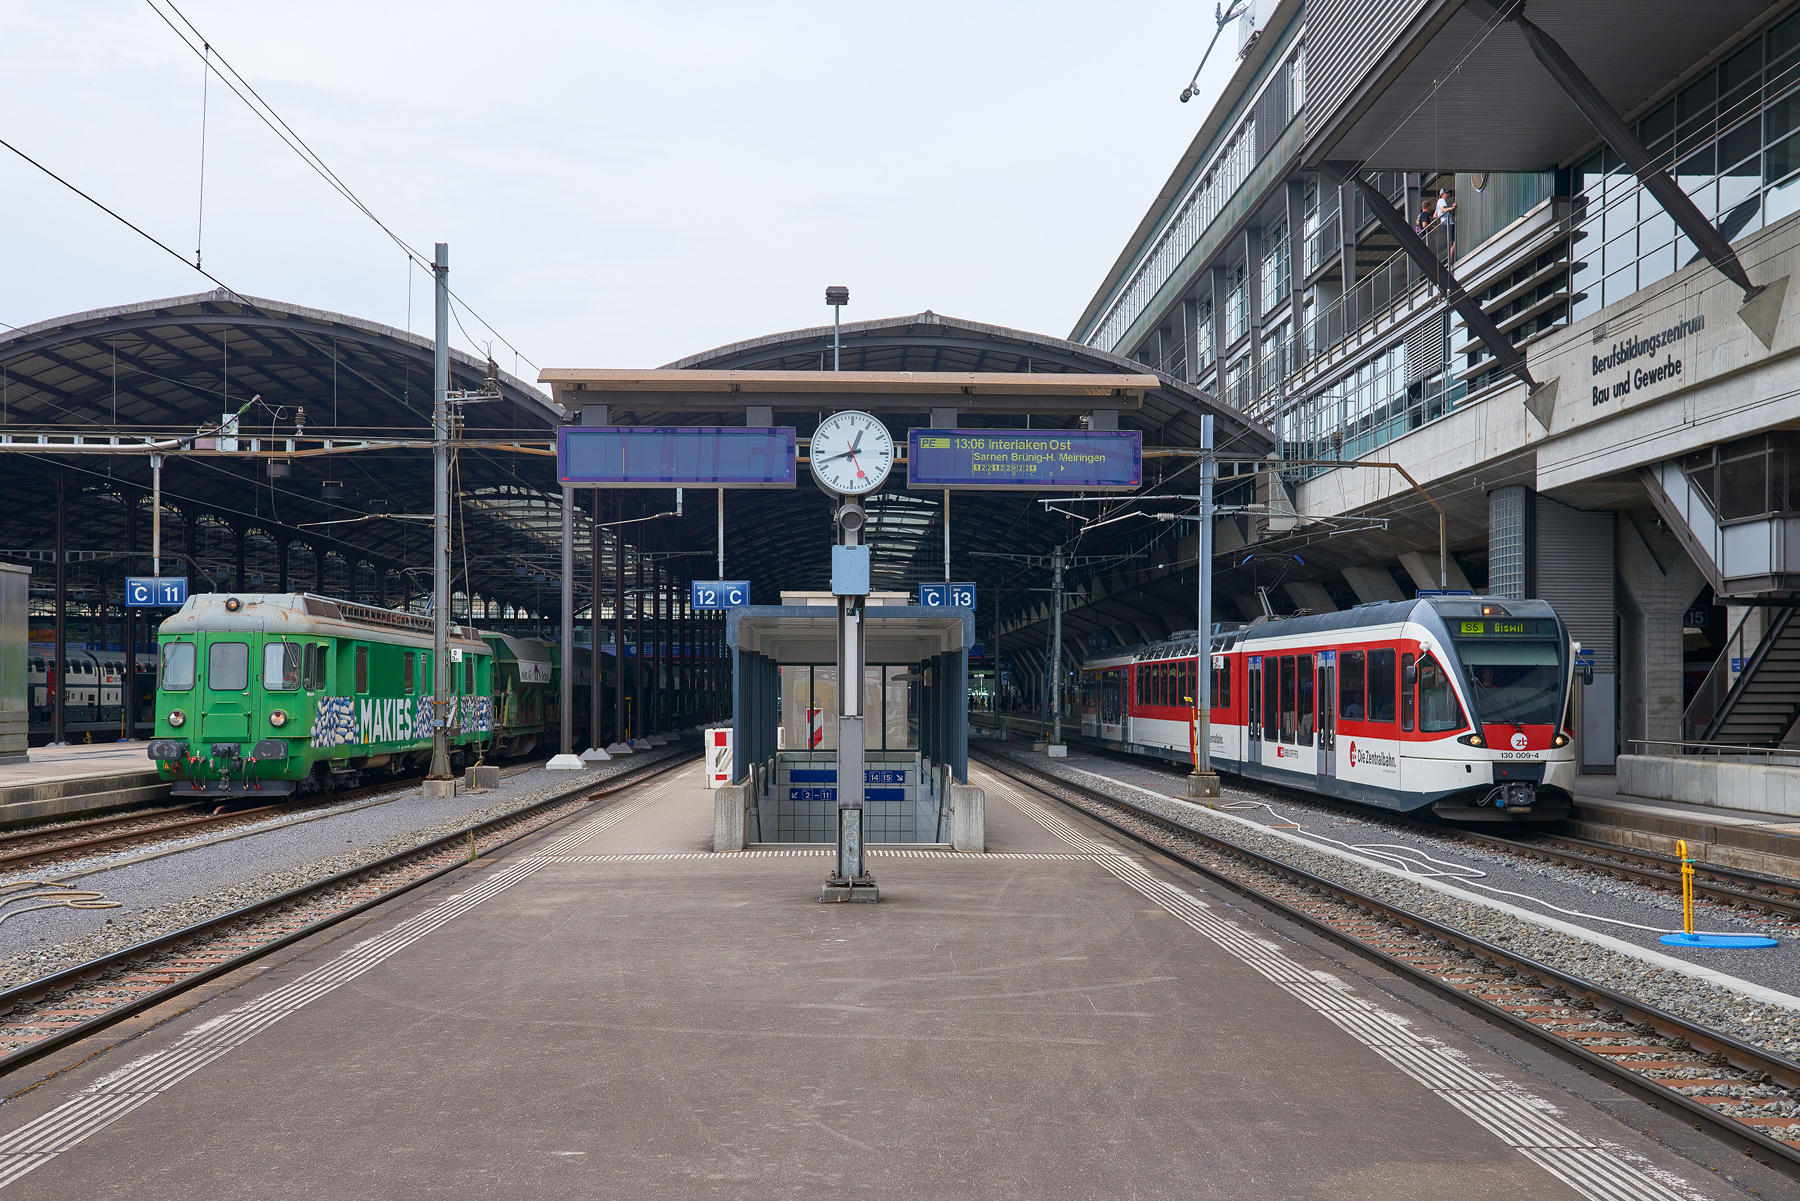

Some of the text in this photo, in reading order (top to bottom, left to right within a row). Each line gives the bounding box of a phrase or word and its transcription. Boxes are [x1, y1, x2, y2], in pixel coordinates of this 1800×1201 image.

[1592, 314, 1704, 376] Berufsbildungszentrum
[1592, 353, 1682, 406] Bau und Gewerbe
[920, 439, 1072, 450] PE 13:06 Interlaken Ost
[973, 452, 1106, 463] Sarnen Brünig-H. Meiringen
[134, 586, 148, 602] C
[164, 586, 178, 602] 11
[697, 590, 715, 605] 12
[729, 589, 742, 605] C
[927, 591, 940, 607] C
[952, 591, 972, 607] 13
[1688, 611, 1704, 624] 15
[1465, 623, 1479, 632] S5
[1494, 622, 1523, 632] Giswil
[360, 698, 412, 744] MAKIES
[1320, 728, 1324, 744] 2
[1329, 729, 1333, 744] 2
[1357, 749, 1397, 768] Die Zentralbahn.
[804, 791, 811, 799] 2
[822, 791, 830, 799] 11
